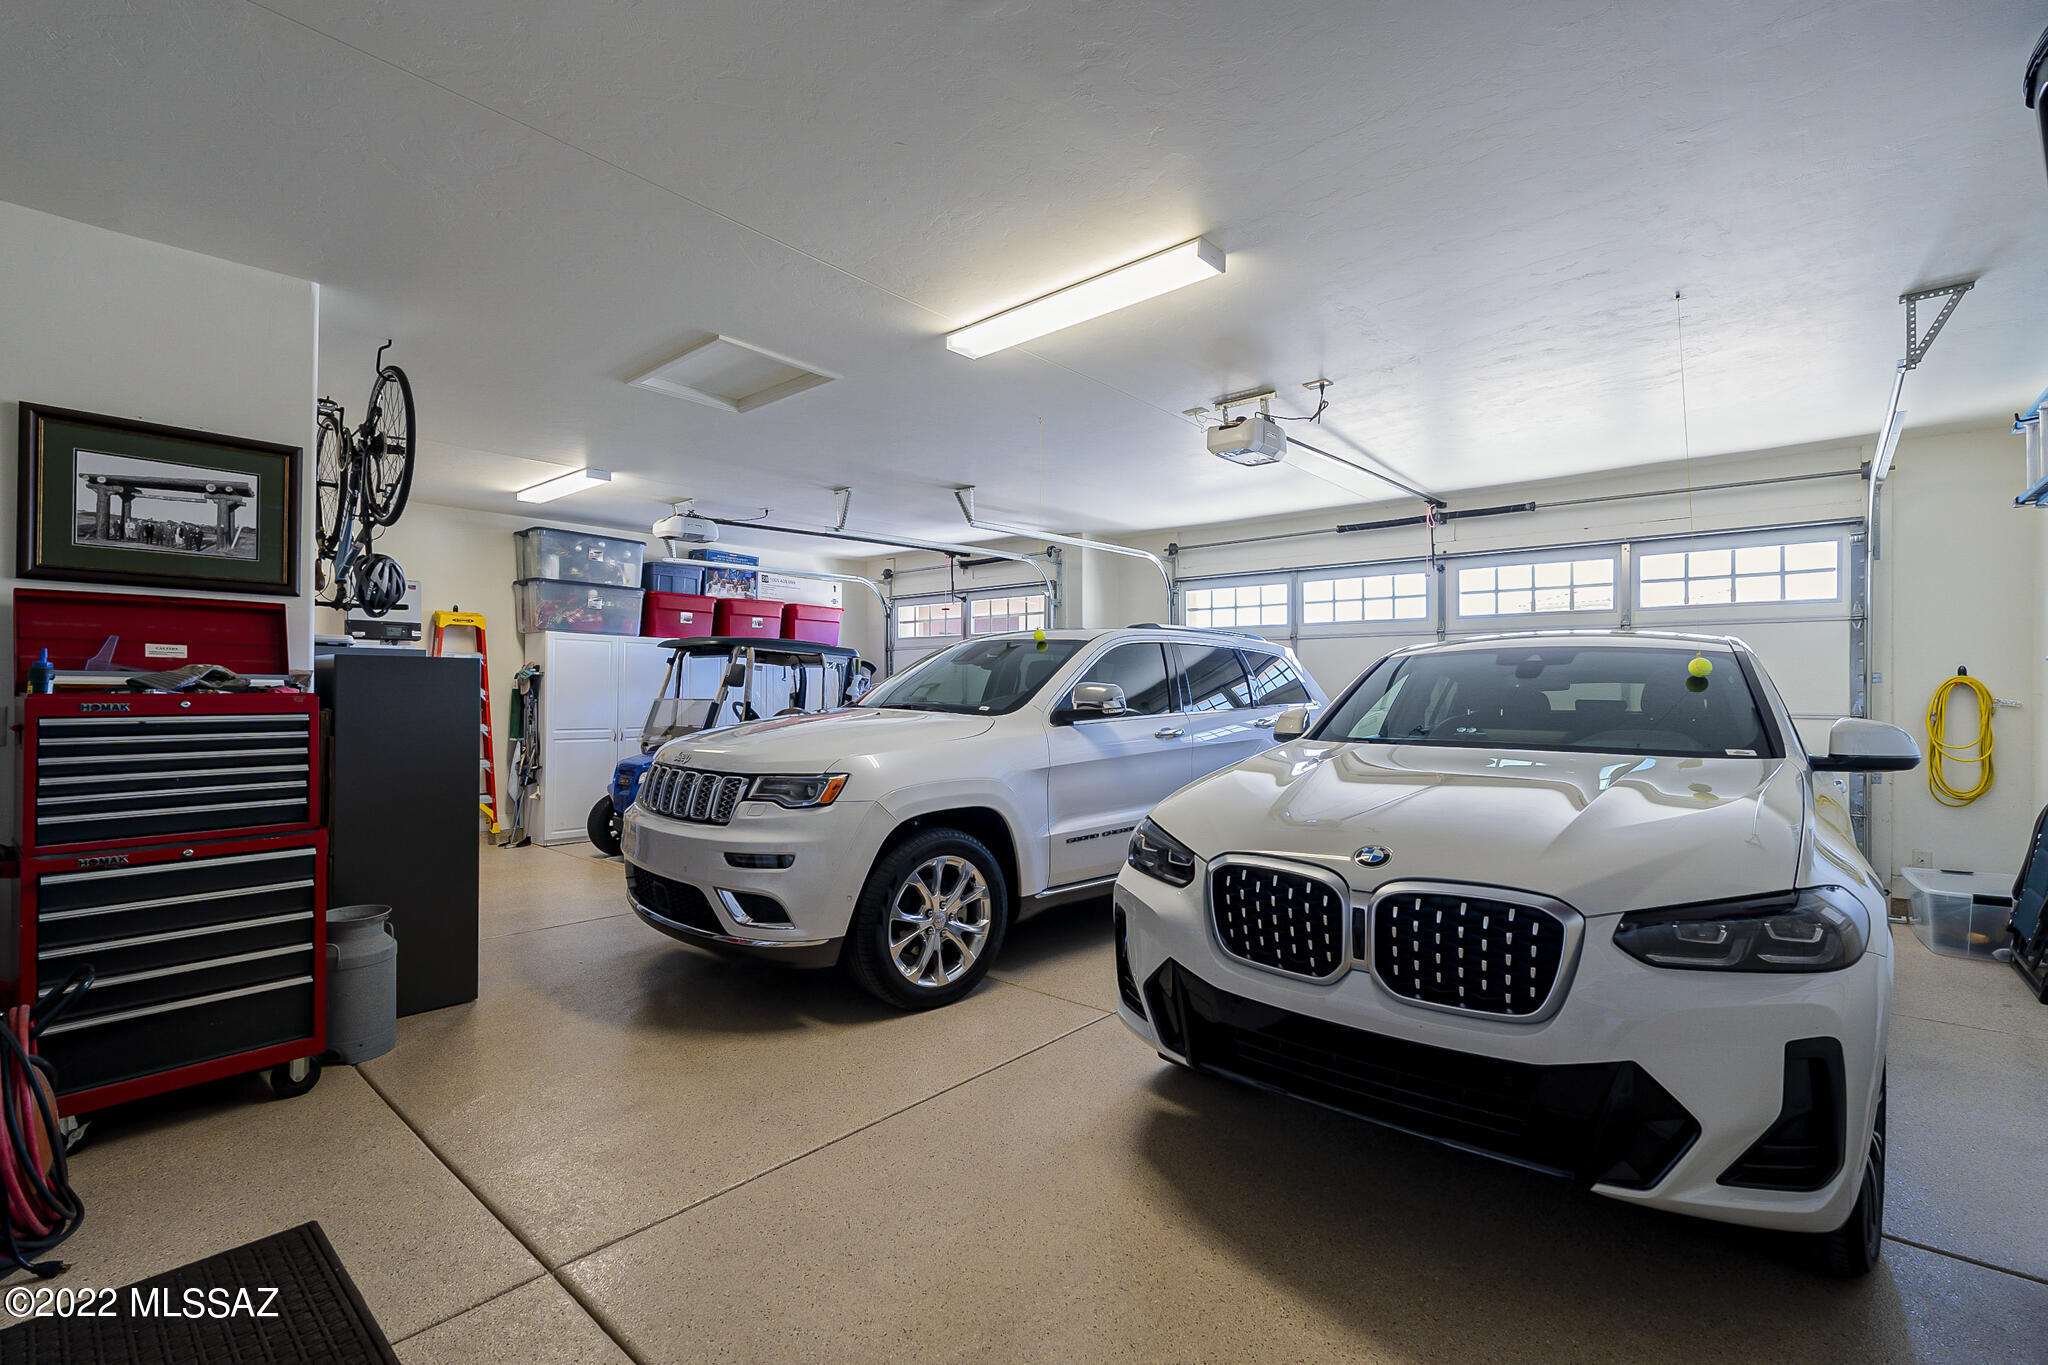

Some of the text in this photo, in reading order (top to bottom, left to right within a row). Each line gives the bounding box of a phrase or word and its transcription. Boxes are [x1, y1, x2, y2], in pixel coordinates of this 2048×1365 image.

[80, 703, 131, 712] HOMAK
[673, 751, 692, 765] Jeep
[78, 855, 129, 867] HOMAK
